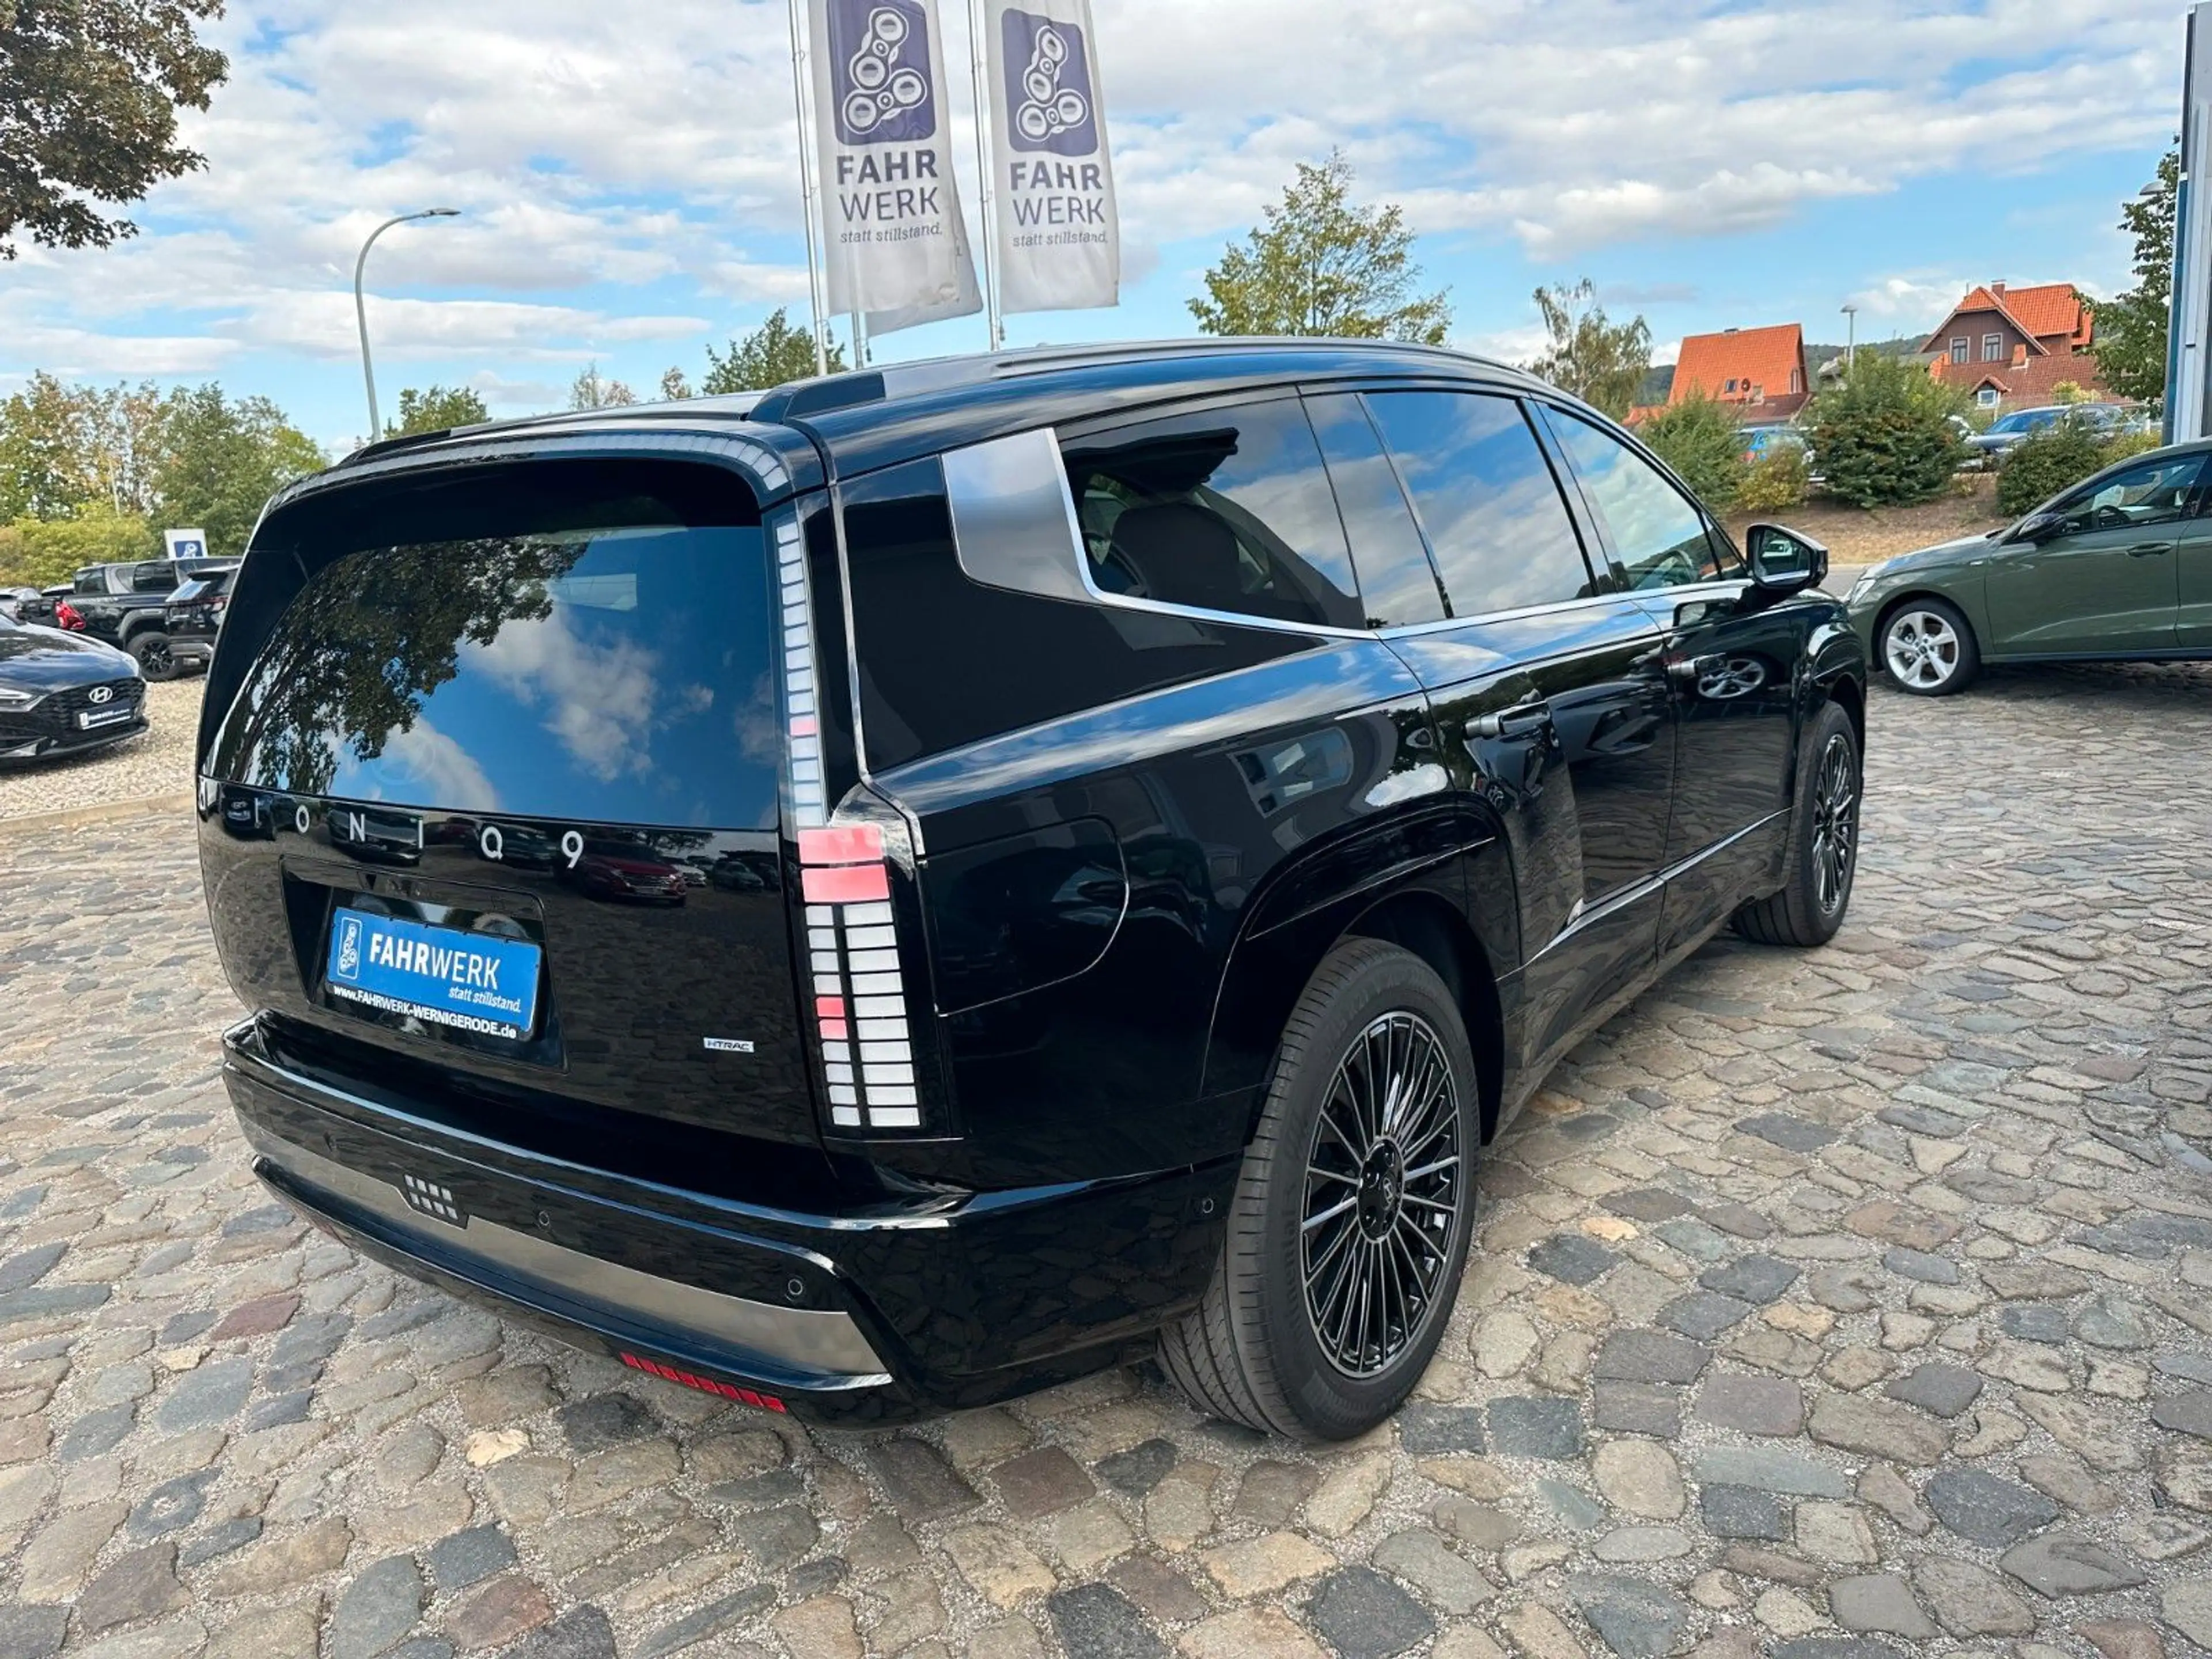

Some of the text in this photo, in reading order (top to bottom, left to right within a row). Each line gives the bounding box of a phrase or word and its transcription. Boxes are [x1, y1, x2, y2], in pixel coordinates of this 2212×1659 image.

[837, 149, 938, 185] FAHR
[1010, 160, 1103, 191] FAHR
[839, 187, 940, 222] WERK
[1013, 196, 1105, 226] WERK
[840, 222, 942, 243] statt stillstand.
[1013, 231, 1108, 247] statt stillstand.
[369, 933, 501, 990] FAHRWERK
[334, 985, 517, 1039] www.FAHRWERK-WERNIGERODE.de
[448, 986, 522, 1013] statt stillstand.
[707, 1040, 749, 1050] HTRAC
